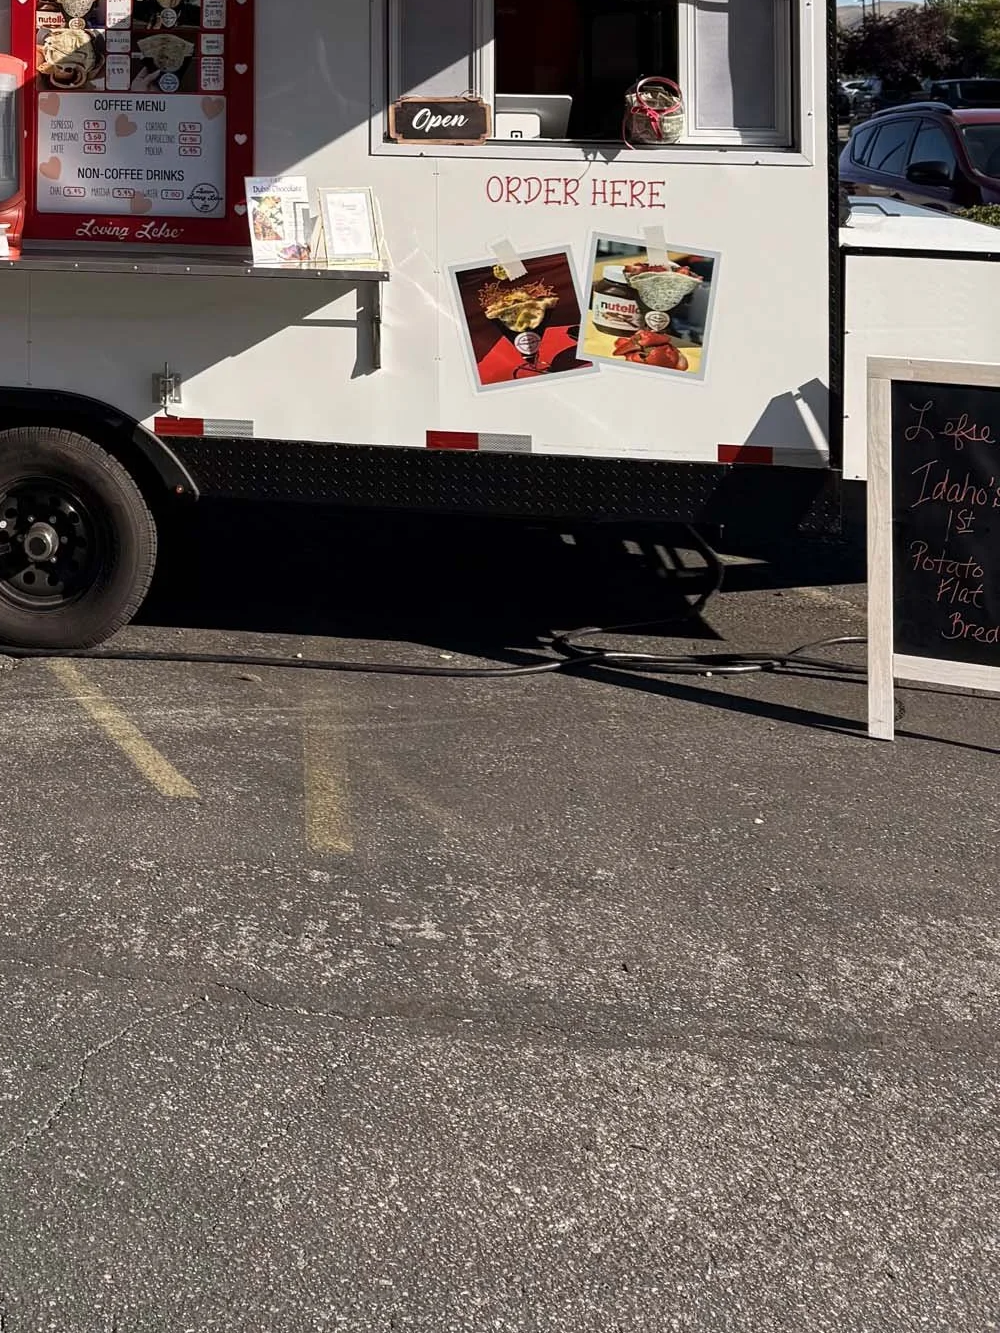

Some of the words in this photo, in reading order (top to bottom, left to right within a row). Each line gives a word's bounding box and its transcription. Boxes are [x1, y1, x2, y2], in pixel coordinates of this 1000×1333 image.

[94, 100, 132, 111] COFFEE
[135, 100, 166, 112] MENU
[412, 108, 468, 131] Open
[77, 168, 142, 180] NON-COFFEE
[146, 170, 184, 181] DRINKS
[486, 176, 580, 206] ORDER
[592, 179, 666, 208] HERE
[76, 219, 129, 239] Loving
[135, 221, 179, 239] Lefse
[905, 401, 995, 450] Lefse
[911, 460, 1000, 508] Idaho's
[910, 540, 984, 578] Potato
[937, 576, 984, 609] Flat
